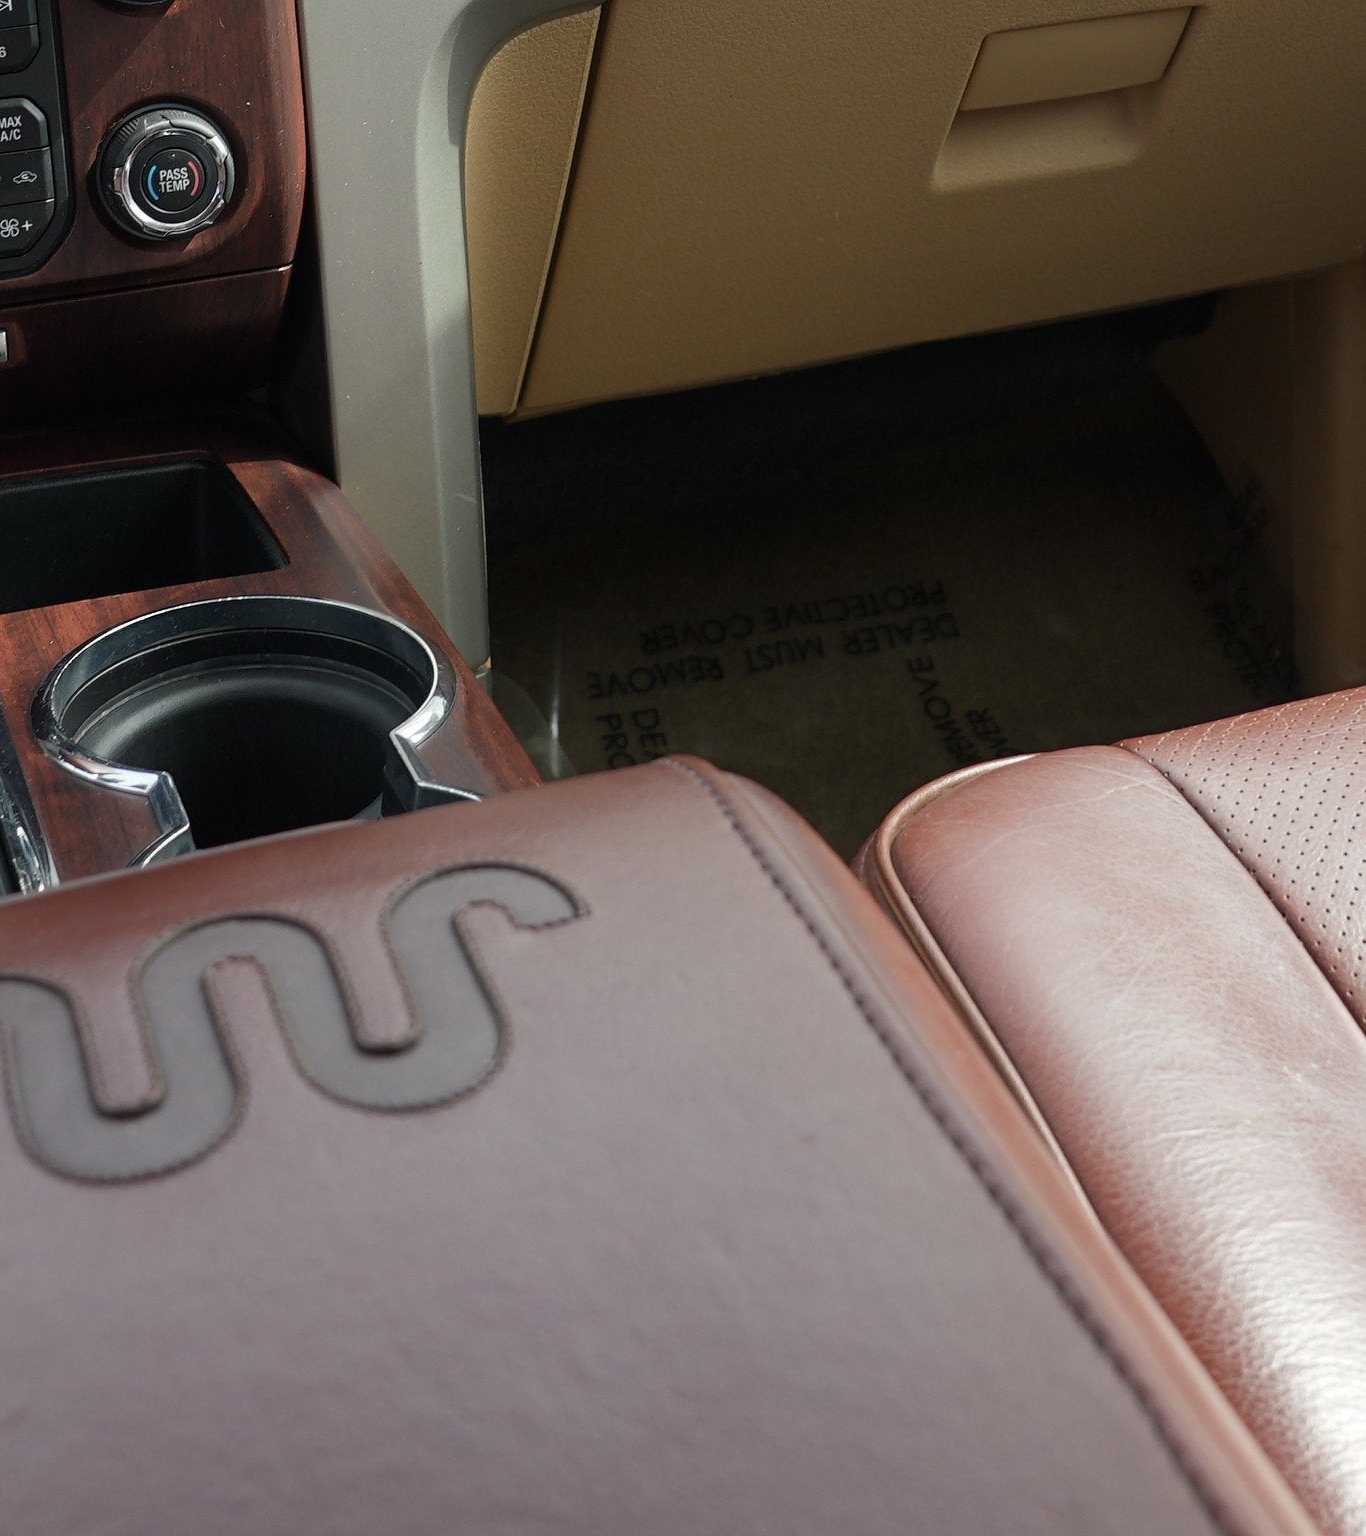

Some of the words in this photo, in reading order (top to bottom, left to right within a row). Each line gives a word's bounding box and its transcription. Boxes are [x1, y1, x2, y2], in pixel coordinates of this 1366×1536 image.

[0, 129, 22, 142] A/C
[159, 167, 189, 181] PASS
[159, 179, 190, 194] TEMP
[761, 581, 947, 632] PROTECTIVE
[638, 613, 753, 656] COVER
[742, 635, 824, 674] MUST
[842, 613, 960, 656] DEALER
[586, 654, 725, 700] REMOVE
